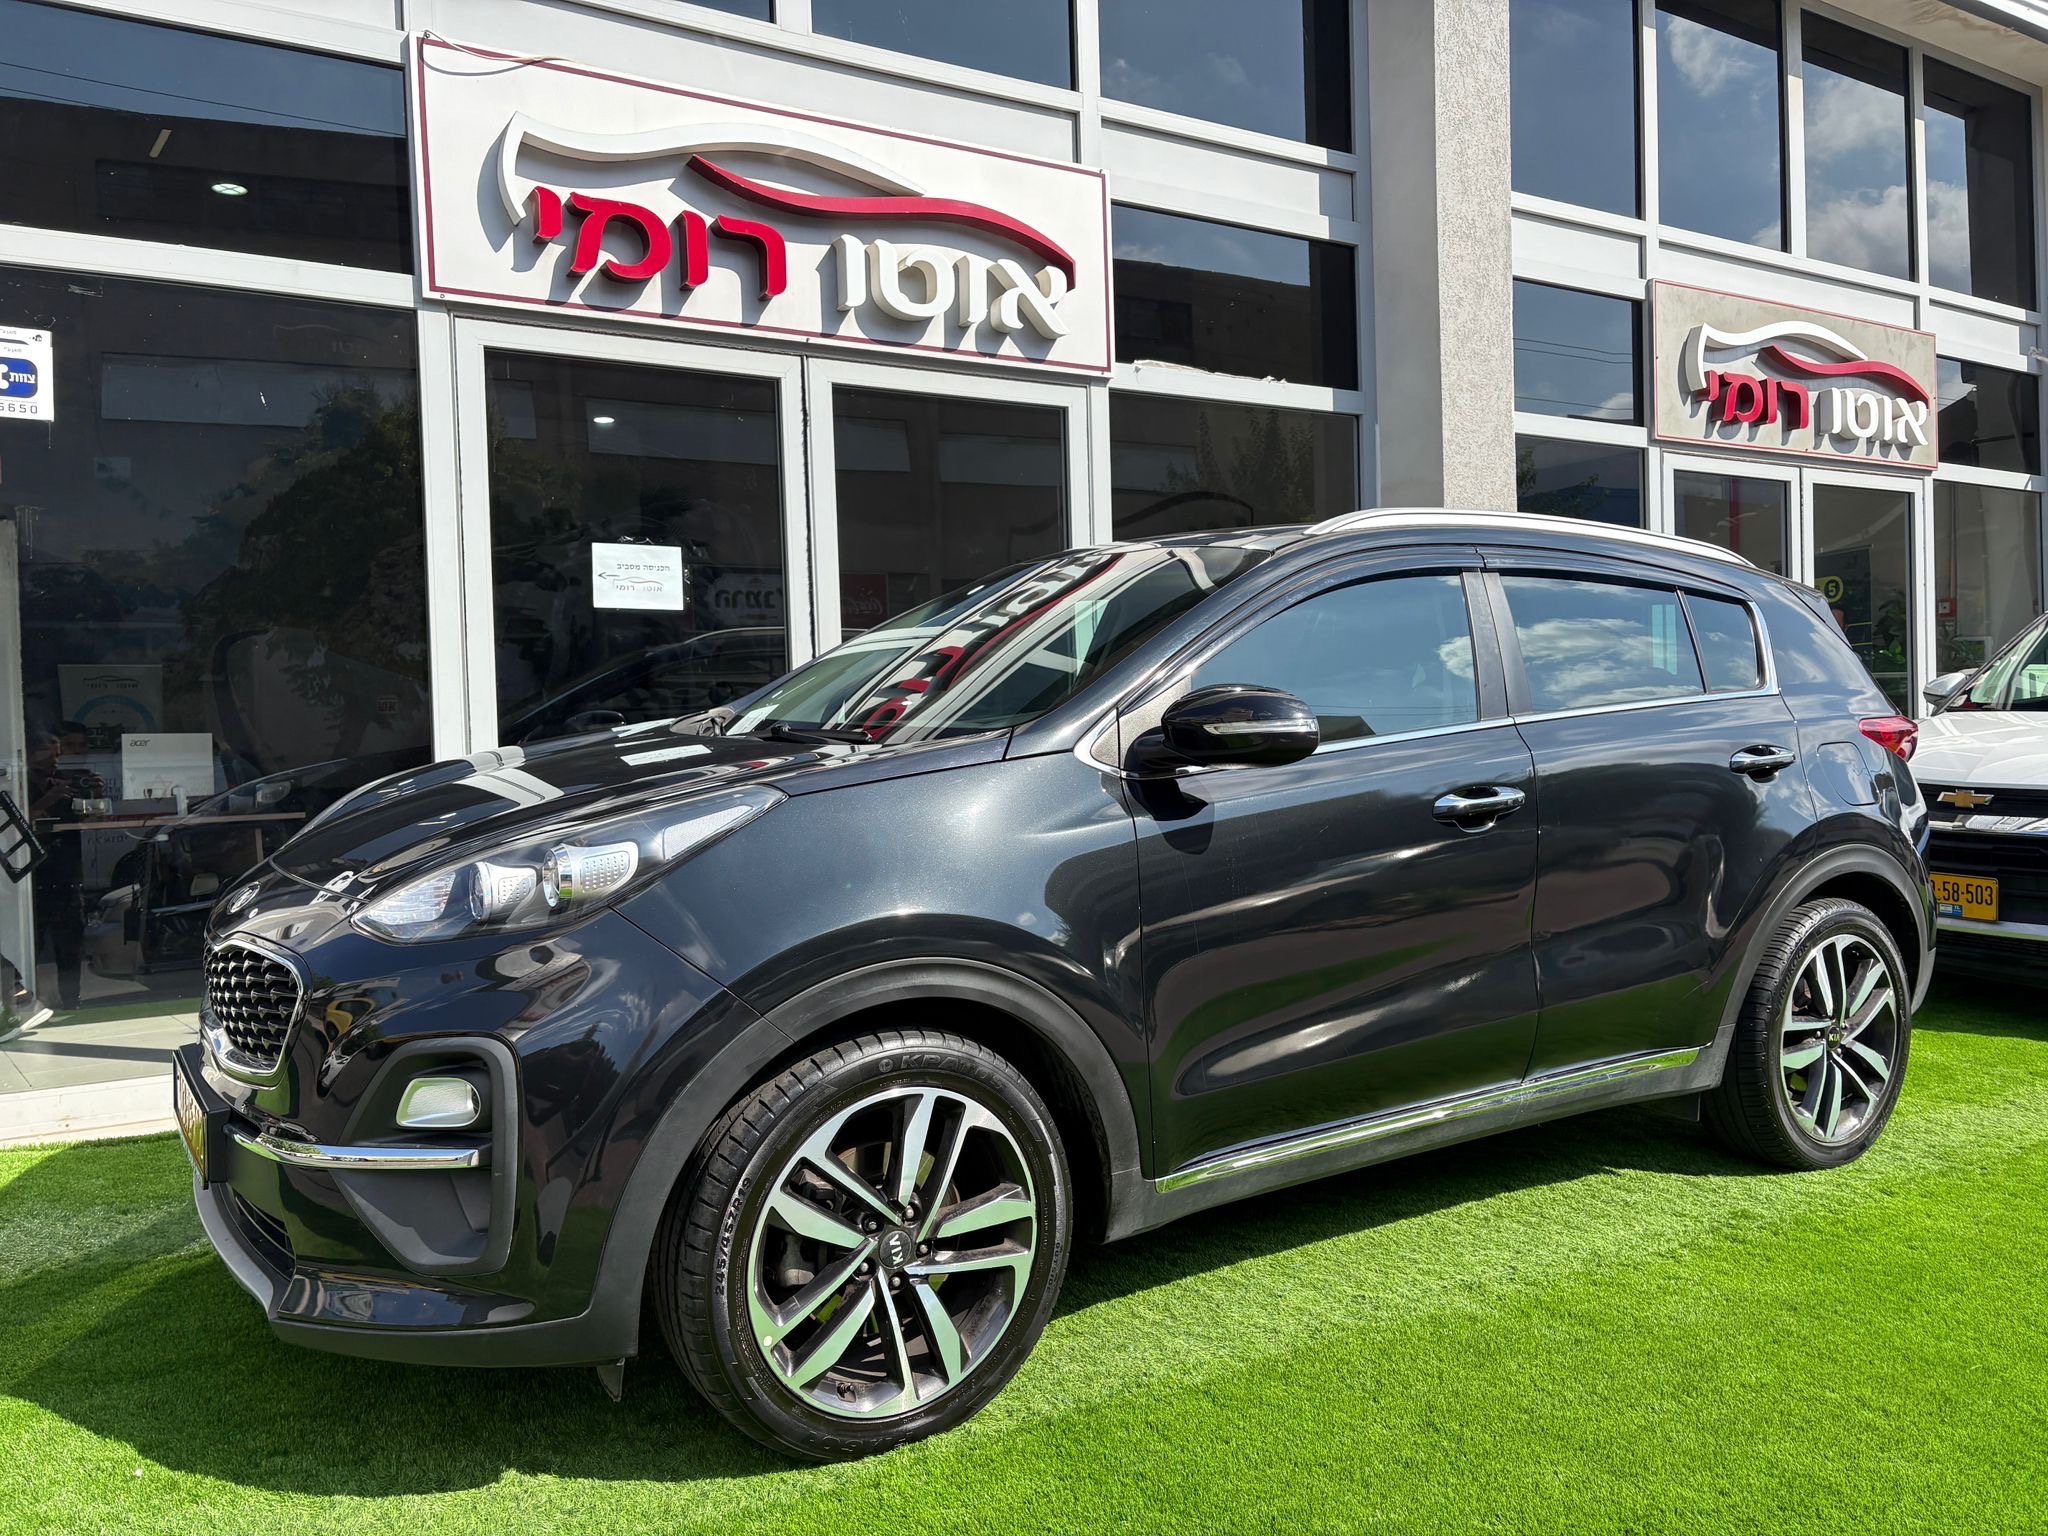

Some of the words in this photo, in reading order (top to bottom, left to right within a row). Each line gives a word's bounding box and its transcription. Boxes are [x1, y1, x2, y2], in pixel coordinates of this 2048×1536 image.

[531, 184, 787, 300] רומי
[831, 233, 1071, 340] אוטו
[8, 371, 36, 384] צוות
[1700, 369, 1810, 432] רומי
[1824, 386, 1930, 447] אוטו
[642, 564, 671, 572] הכניסה
[129, 738, 151, 747] acer
[715, 1177, 752, 1297] 245/45ZR19
[889, 1233, 904, 1265] KIA
